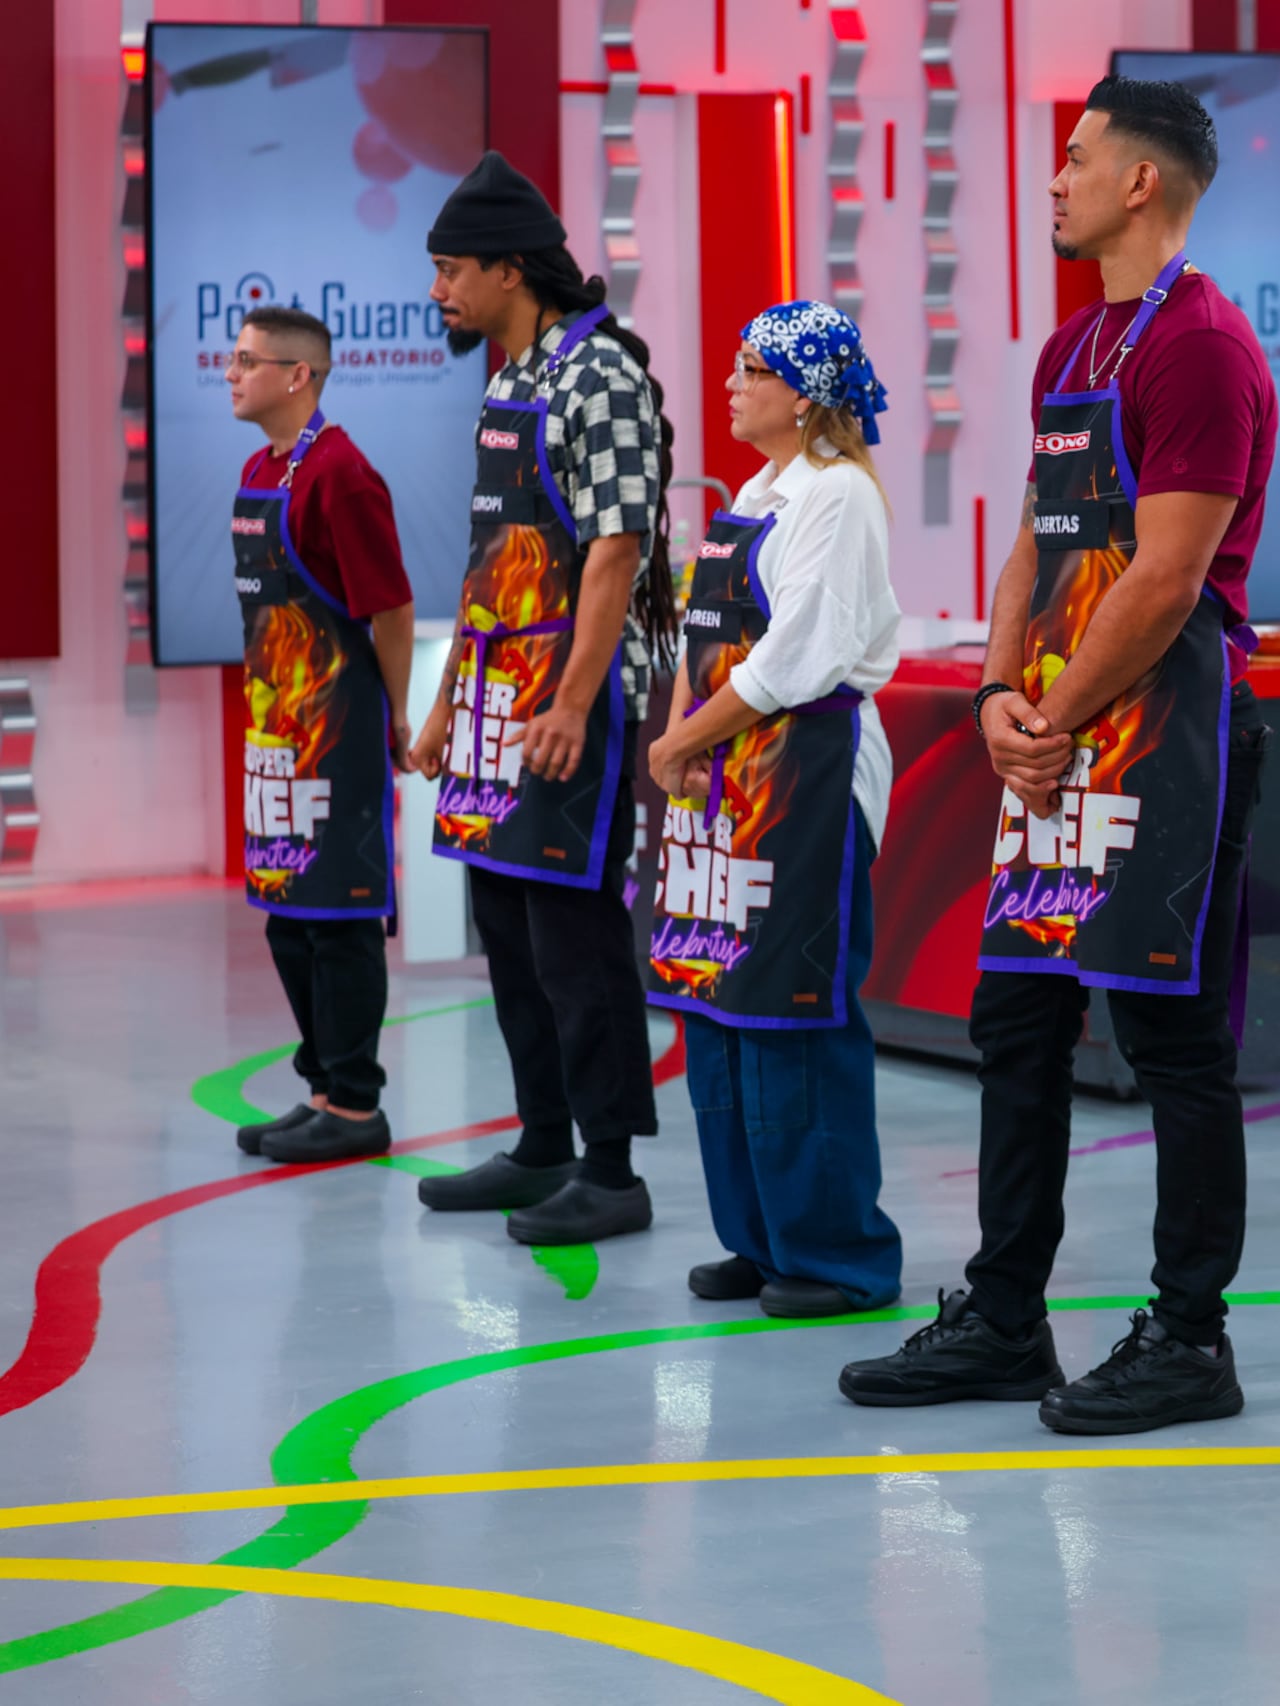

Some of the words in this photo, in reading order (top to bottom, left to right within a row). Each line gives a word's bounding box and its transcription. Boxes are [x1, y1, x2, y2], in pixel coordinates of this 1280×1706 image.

[332, 350, 445, 367] IGATORIO
[1035, 433, 1089, 452] CONO
[244, 773, 331, 841] HEF
[655, 842, 774, 931] HEF
